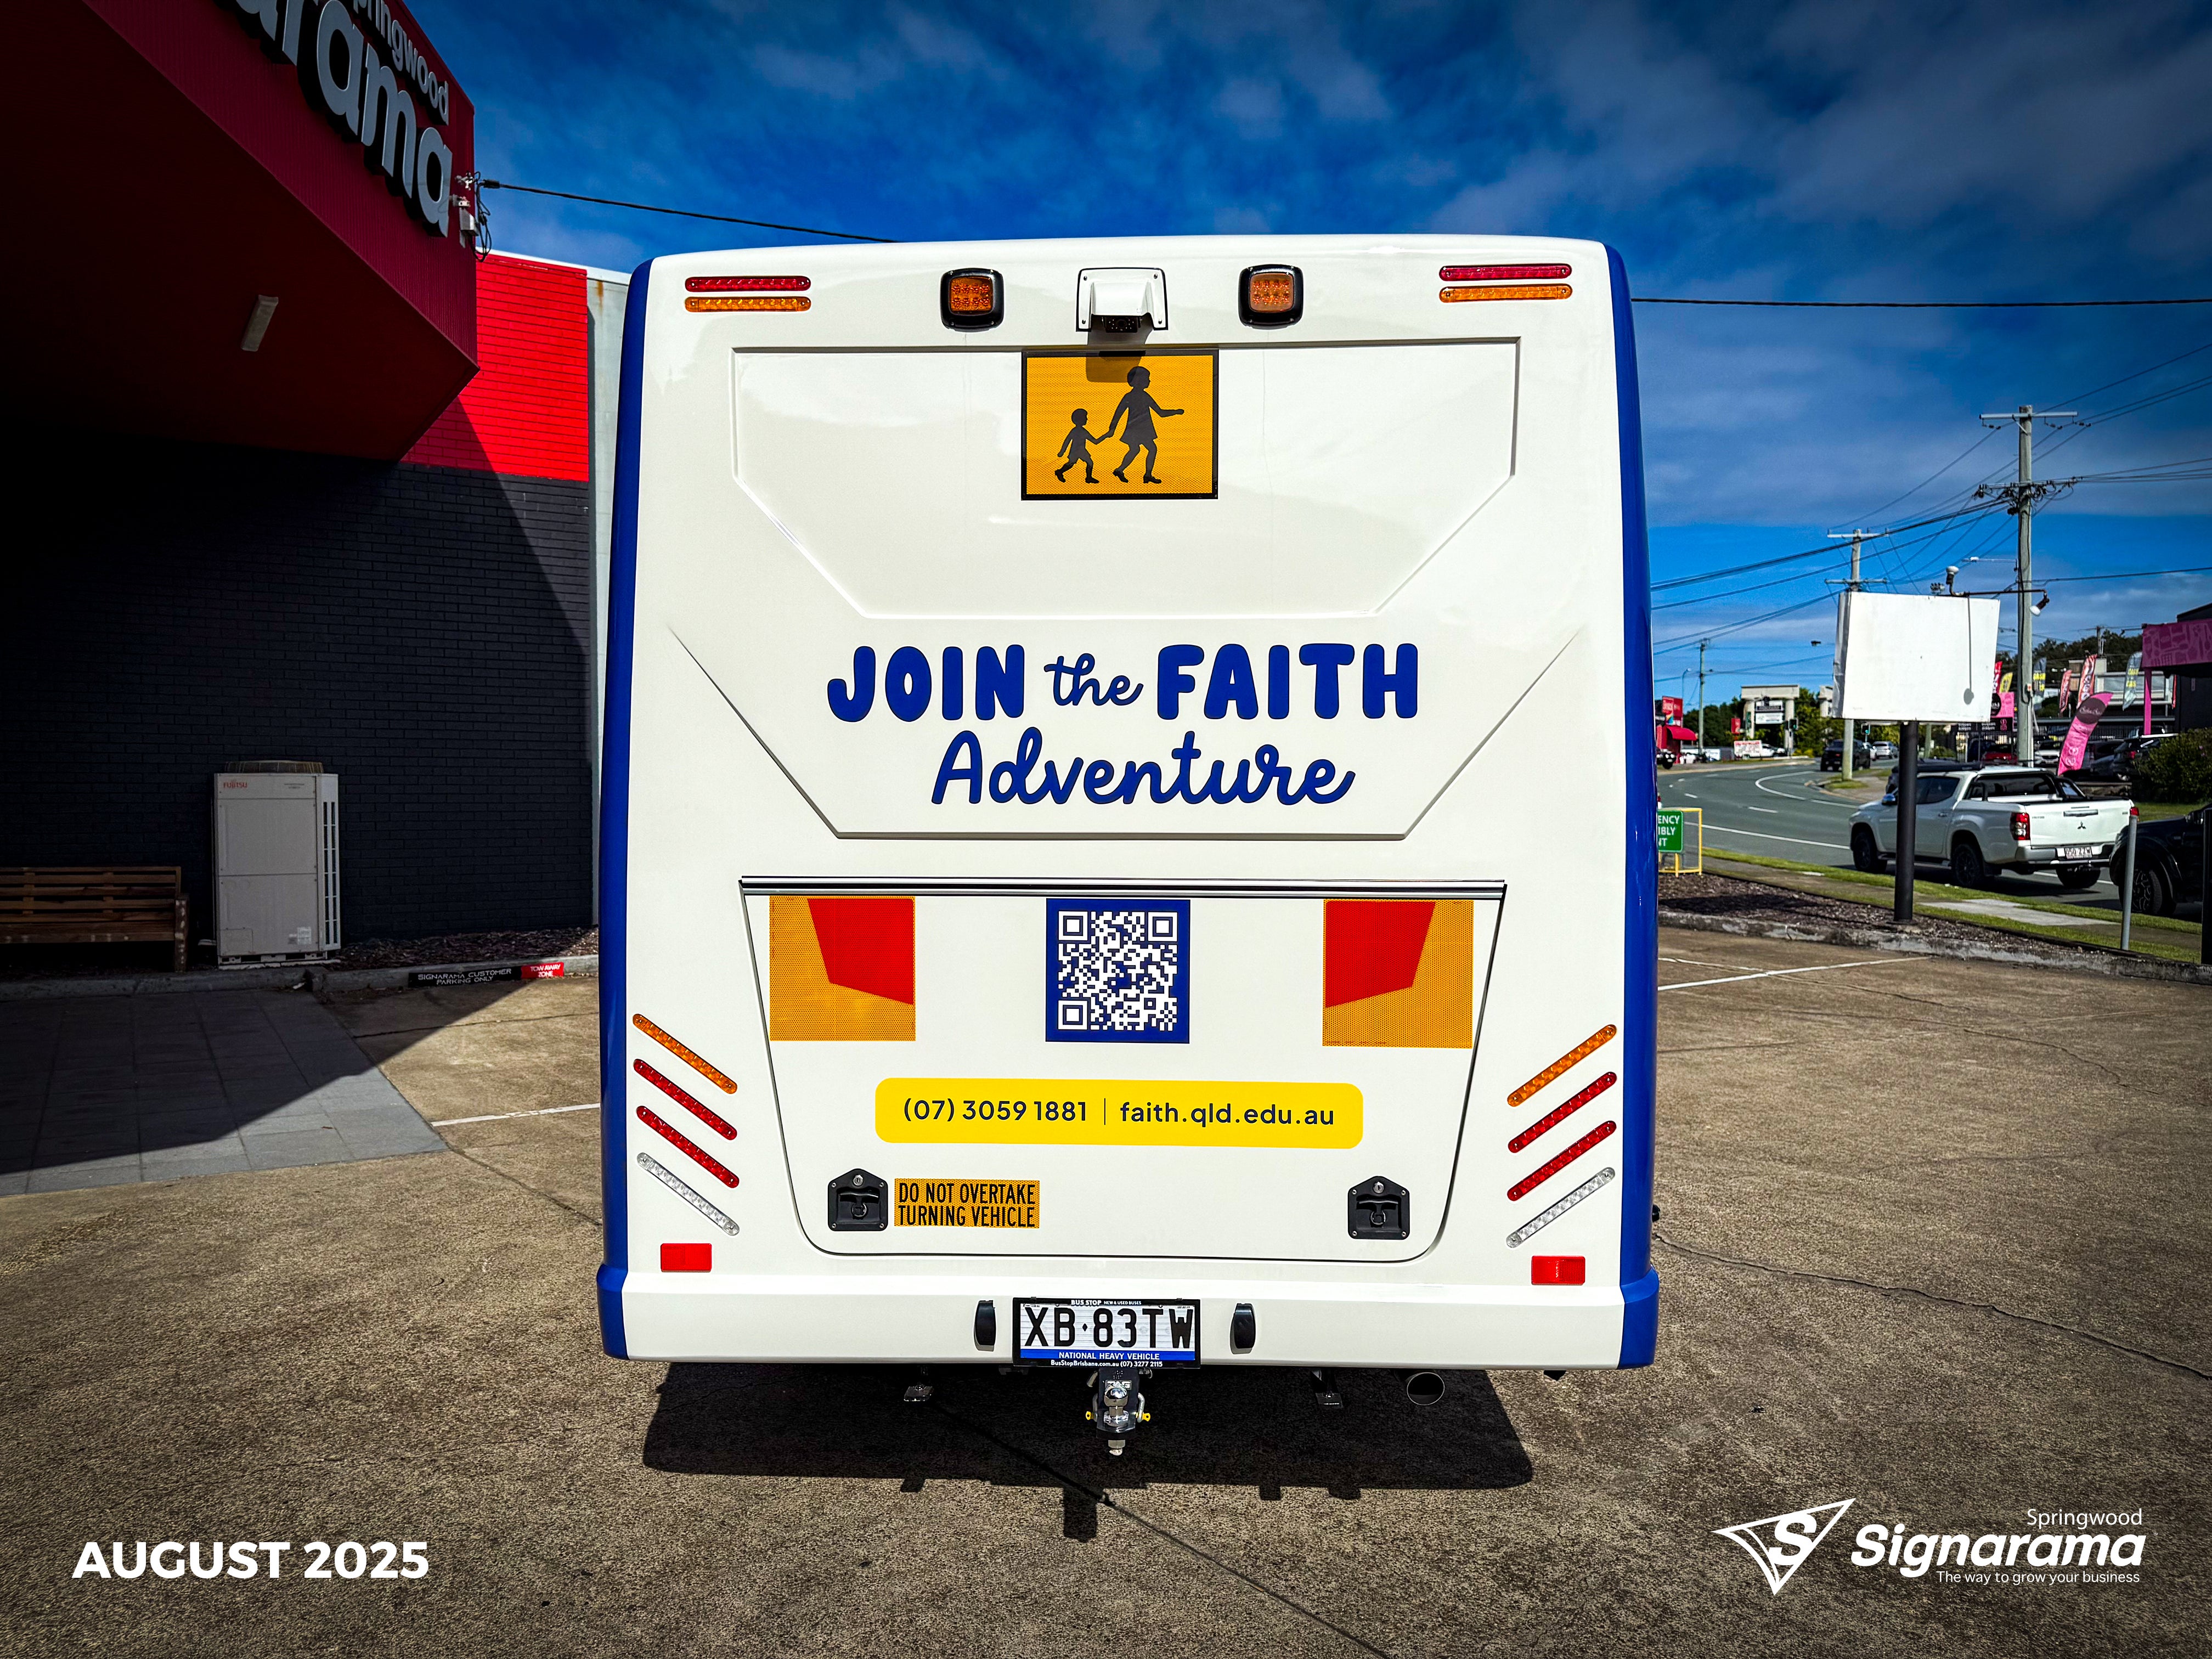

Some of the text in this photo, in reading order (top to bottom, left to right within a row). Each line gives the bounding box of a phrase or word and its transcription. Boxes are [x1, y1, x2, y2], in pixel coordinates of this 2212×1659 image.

[827, 643, 1419, 722] JOIN the FAITH
[932, 727, 1356, 805] Adventure
[1658, 827, 1675, 836] BLY
[468, 969, 511, 978] CUSTOMER
[904, 1098, 1334, 1128] (07) 3059 1881 faith.qld.edu.au
[899, 1183, 1036, 1204] DO NOT OVERTAKE
[898, 1205, 1035, 1227] TURNING VEHICLE
